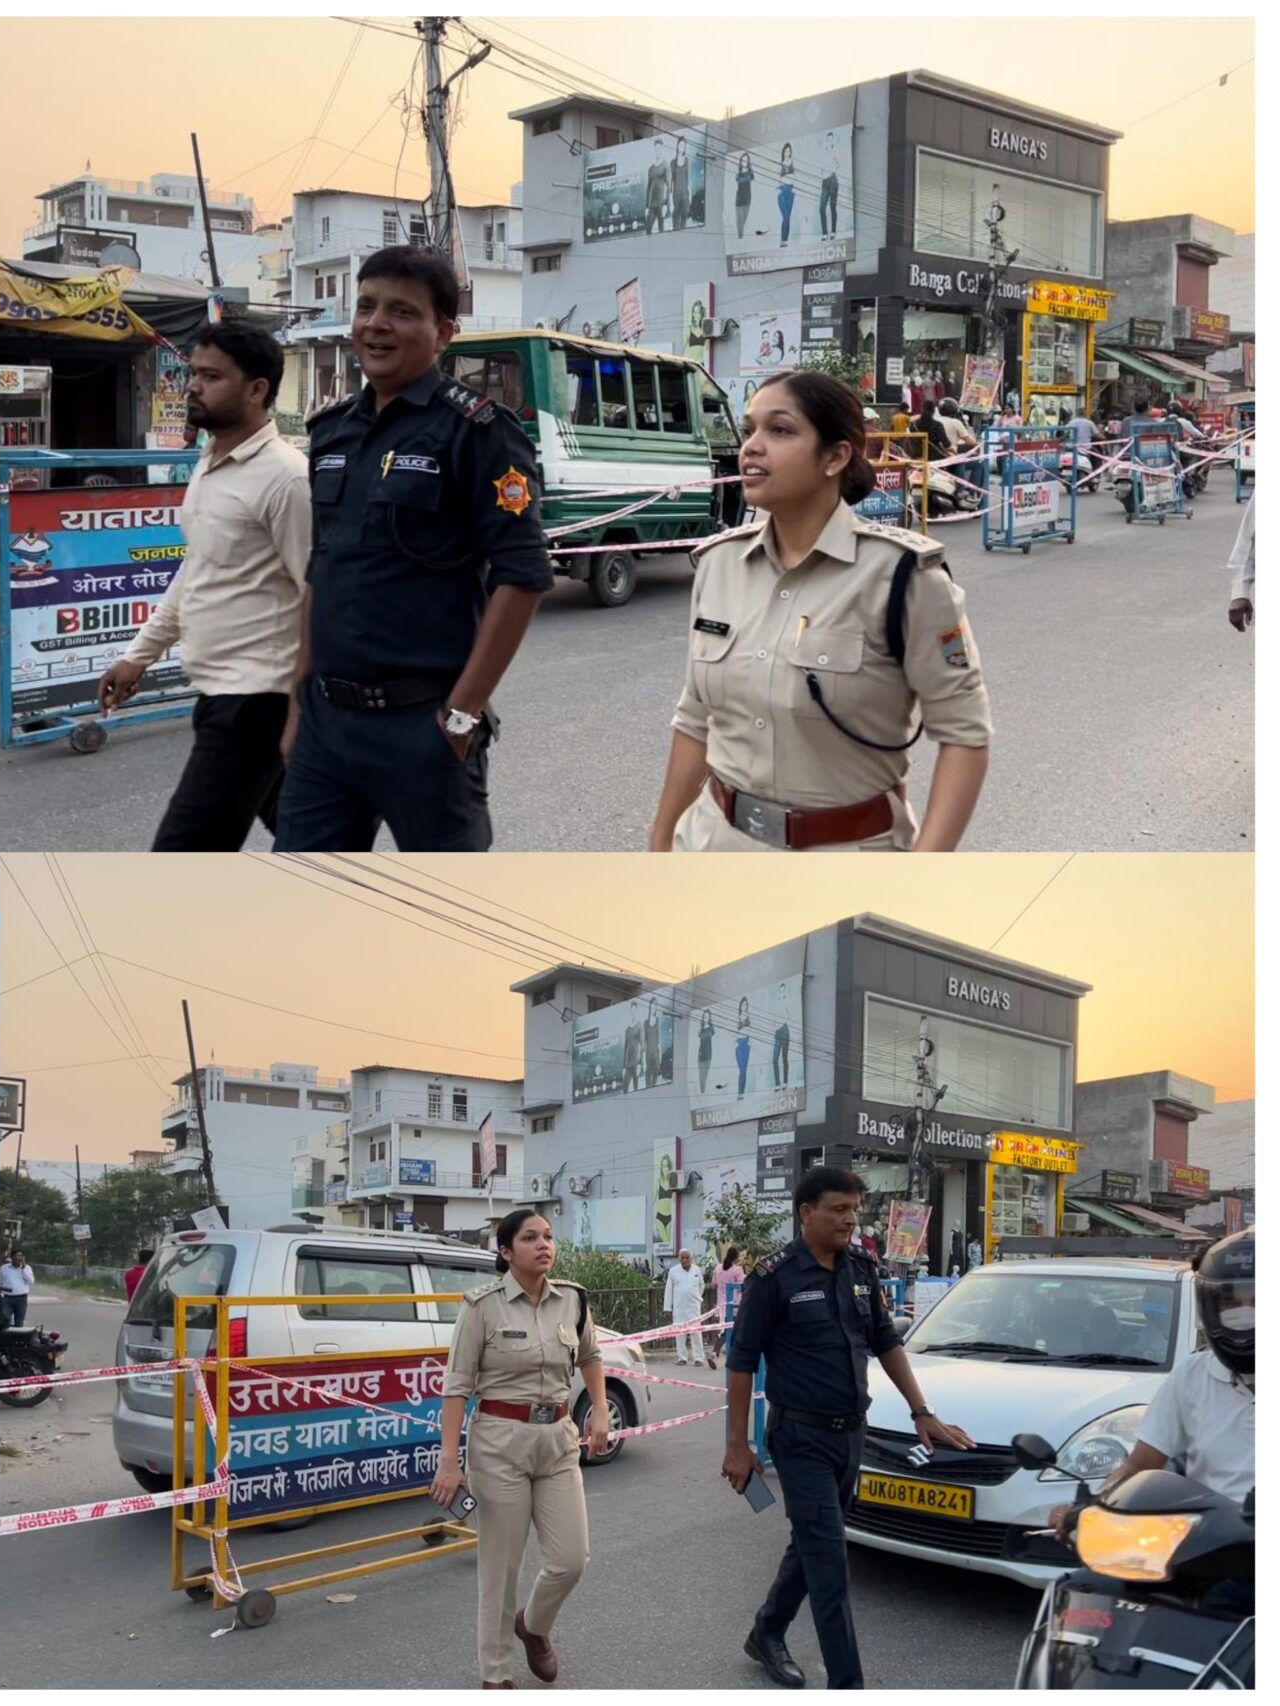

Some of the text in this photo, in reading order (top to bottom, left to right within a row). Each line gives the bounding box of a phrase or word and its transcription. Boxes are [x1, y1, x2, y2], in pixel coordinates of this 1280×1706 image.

[990, 128, 1048, 161] BANGA'S
[909, 264, 952, 297] Banga
[394, 458, 430, 468] POLICE
[73, 568, 172, 594] ओवर लोड
[39, 639, 62, 650] GST
[65, 635, 98, 648] Billing
[100, 632, 108, 641] &
[948, 977, 1010, 1010] BANGA'S
[858, 1112, 905, 1145] Banga
[924, 1122, 982, 1149] ollection
[1013, 1153, 1068, 1171] FACTORY OUTLET
[296, 1419, 351, 1449] यात्रा
[357, 1409, 410, 1441] मेला
[294, 1458, 355, 1493] पंतजलि
[868, 1479, 967, 1512] UK08TA8241
[17, 1513, 79, 1531] CAUTION
[1115, 1599, 1149, 1613] TVS
